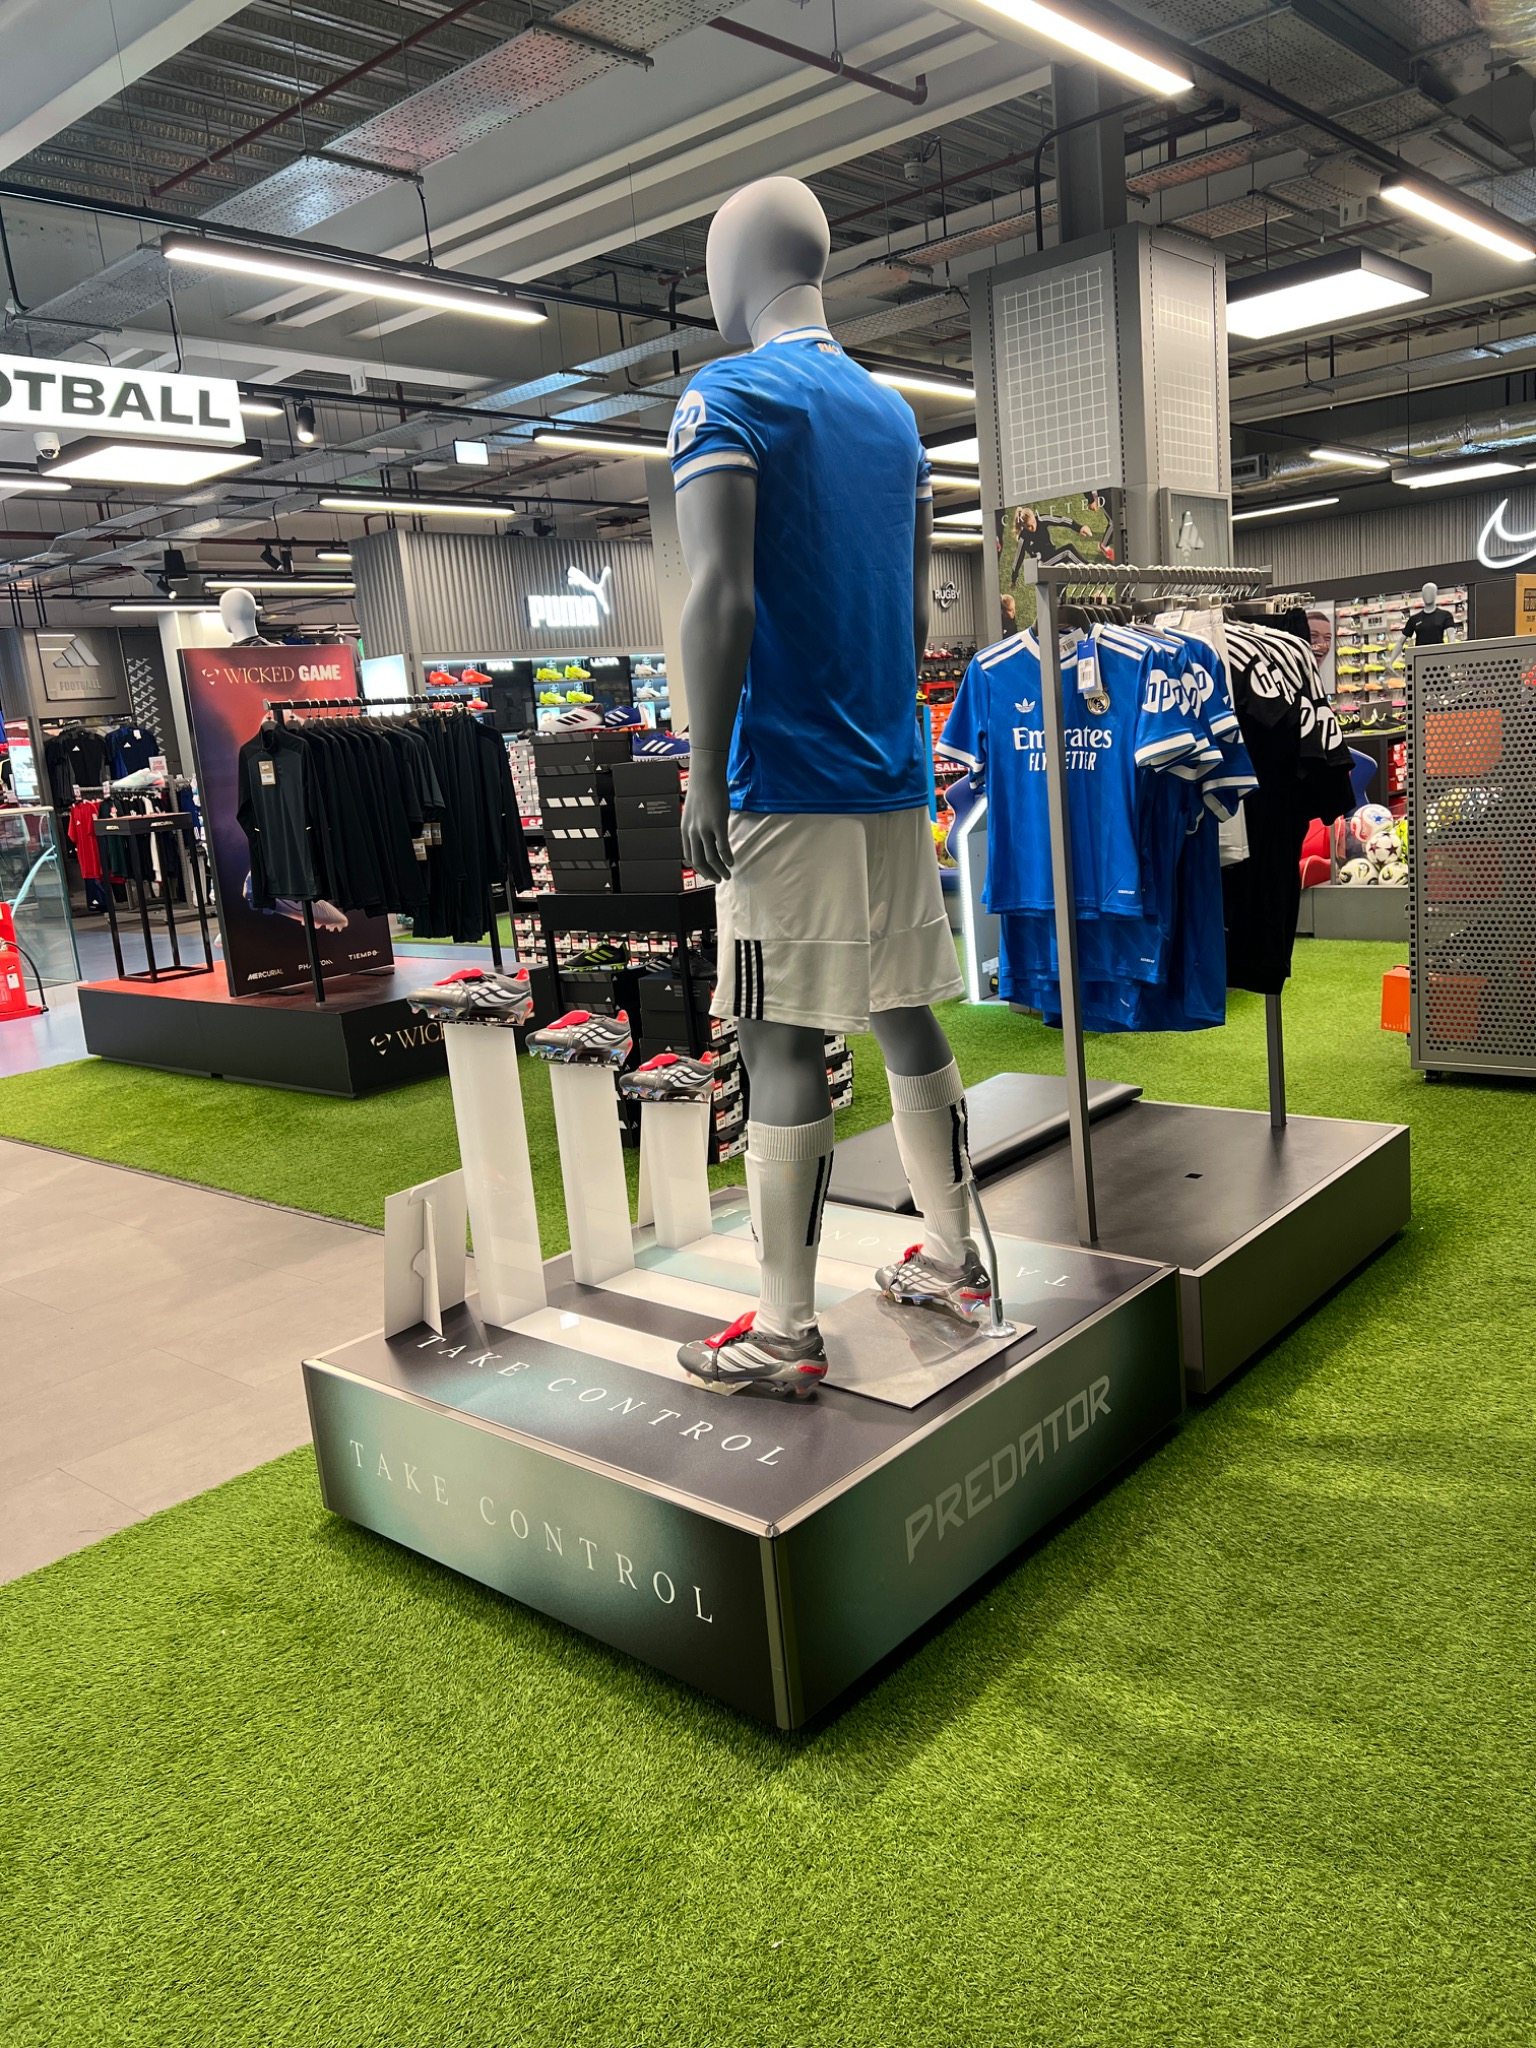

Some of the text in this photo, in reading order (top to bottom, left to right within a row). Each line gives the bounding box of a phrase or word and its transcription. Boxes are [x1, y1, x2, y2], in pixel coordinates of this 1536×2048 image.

[0, 368, 231, 428] TBALL
[1001, 496, 1106, 527] CRAFTED
[934, 589, 961, 600] RUGBY
[527, 594, 600, 629] PUMA
[59, 680, 102, 692] FOOTBALL
[223, 664, 342, 685] WICKED GAME
[1012, 726, 1113, 750] Emrates
[935, 761, 965, 773] SALE
[348, 950, 380, 961] TIEMPO
[247, 968, 284, 981] MERCURIAL
[416, 1334, 785, 1466] TAKE CONTROL
[904, 1375, 1112, 1566] PREDATOR
[349, 1439, 714, 1624] TAKE CONTROL
